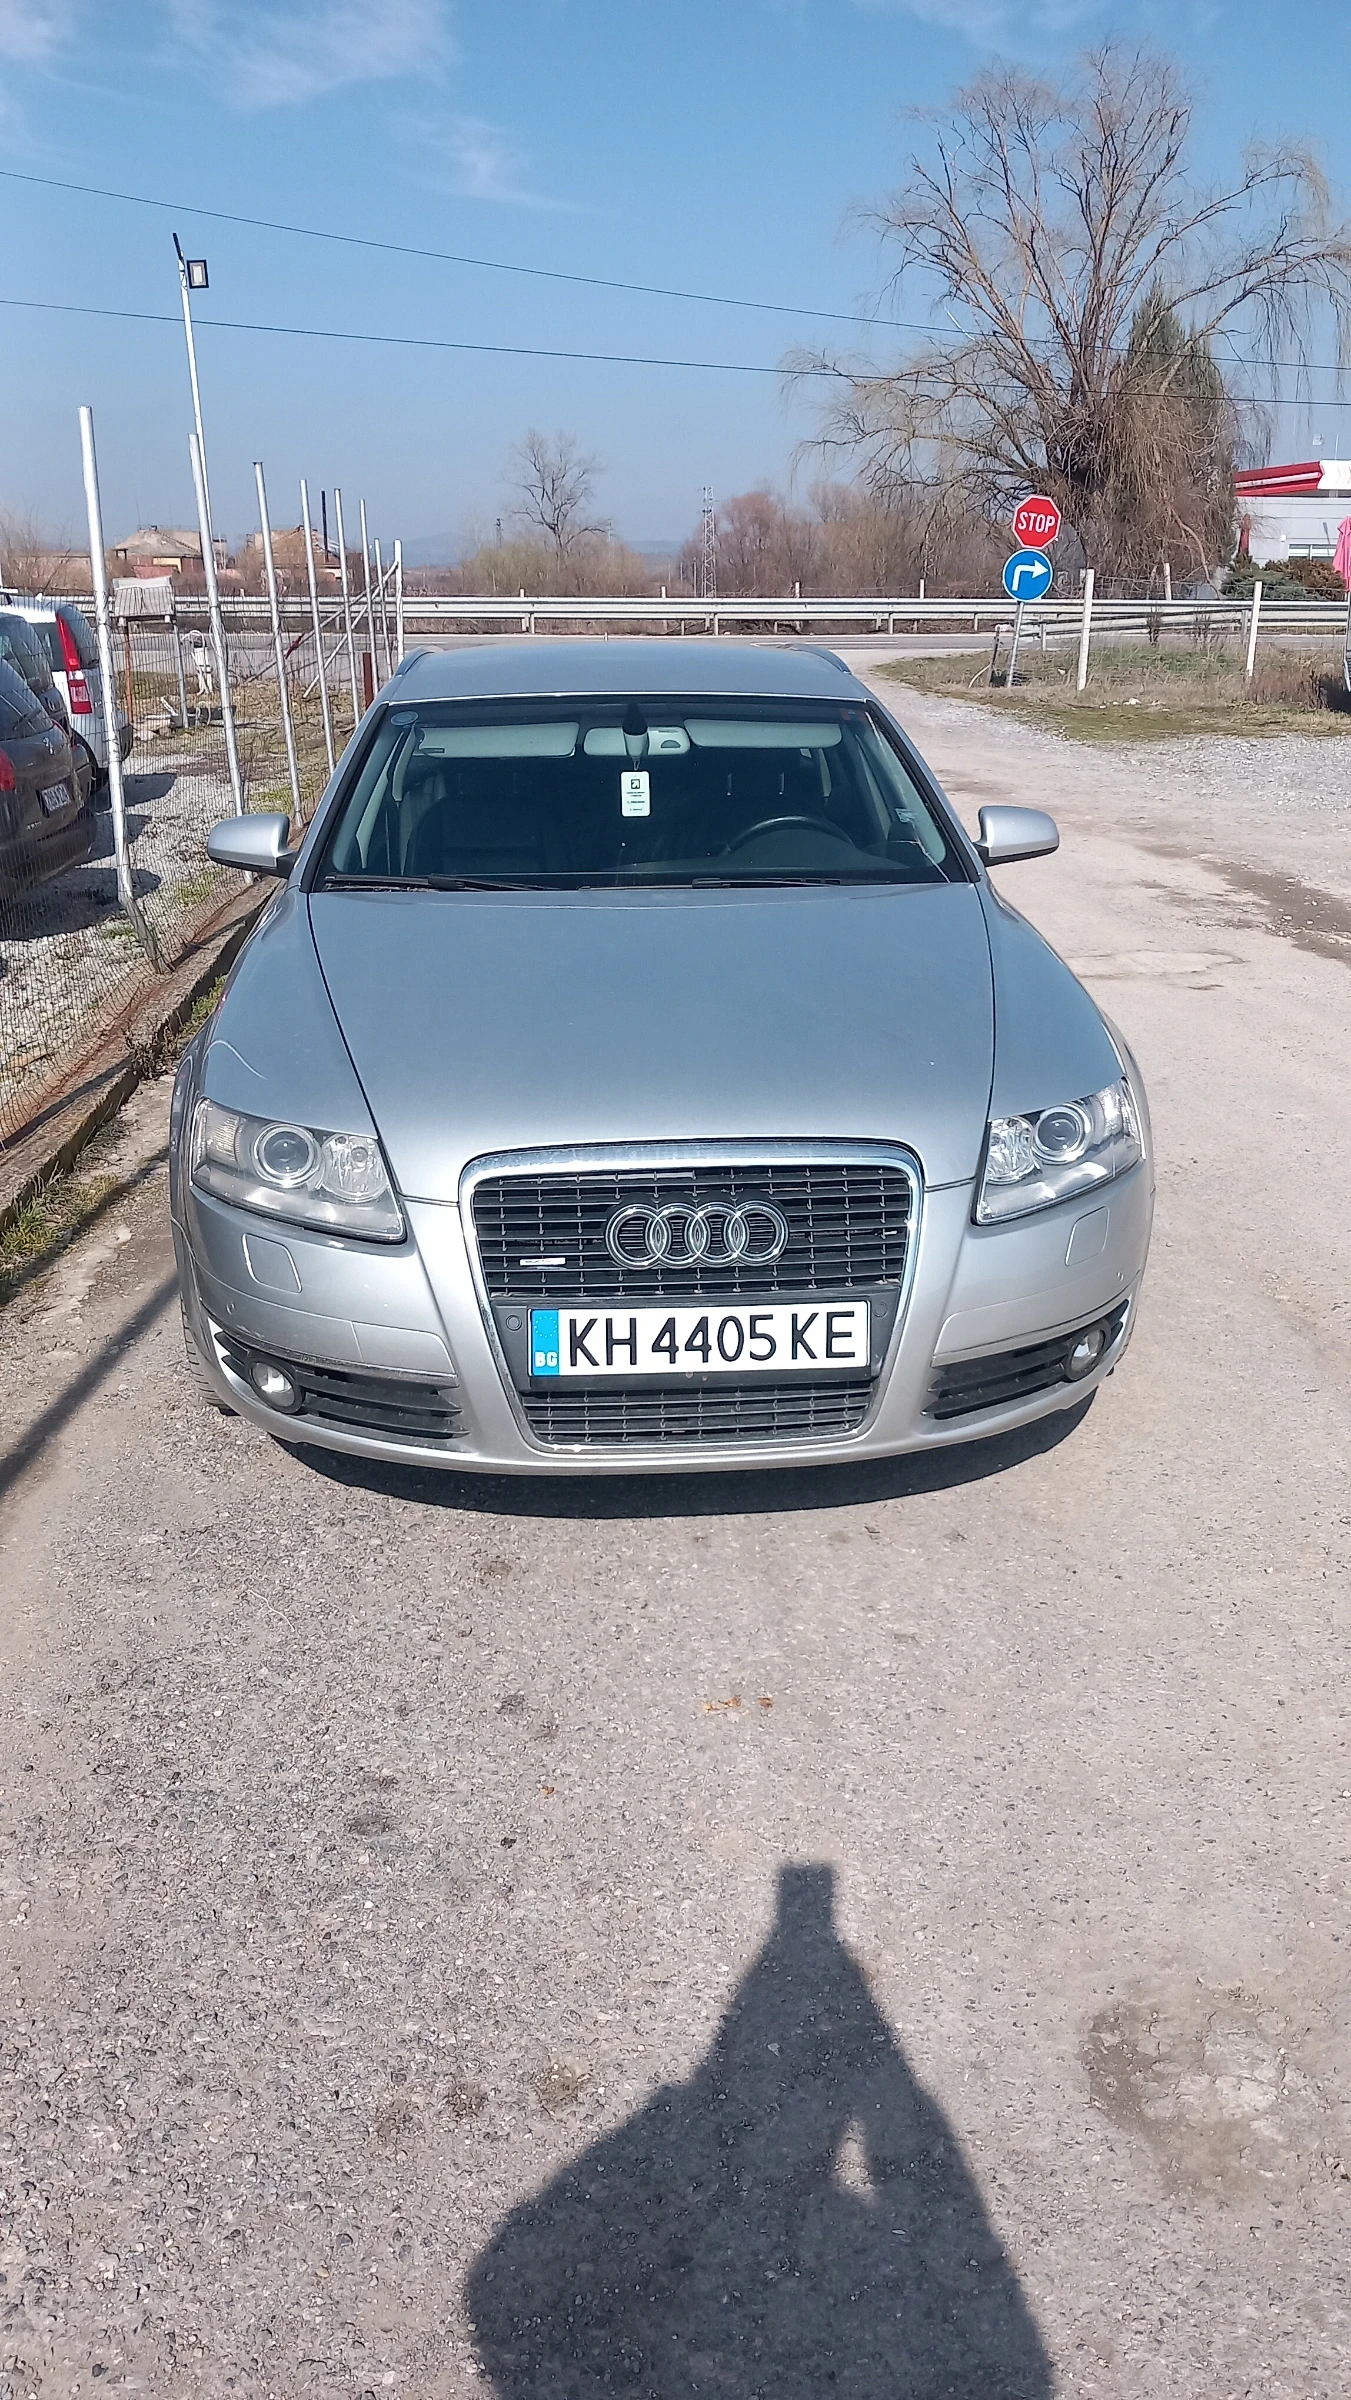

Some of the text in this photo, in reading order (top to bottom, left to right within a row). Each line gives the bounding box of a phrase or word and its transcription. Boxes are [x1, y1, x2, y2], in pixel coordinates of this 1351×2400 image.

[1017, 511, 1056, 534] STOP
[568, 1310, 856, 1367] KH 4405 KE
[534, 1351, 558, 1368] BG
